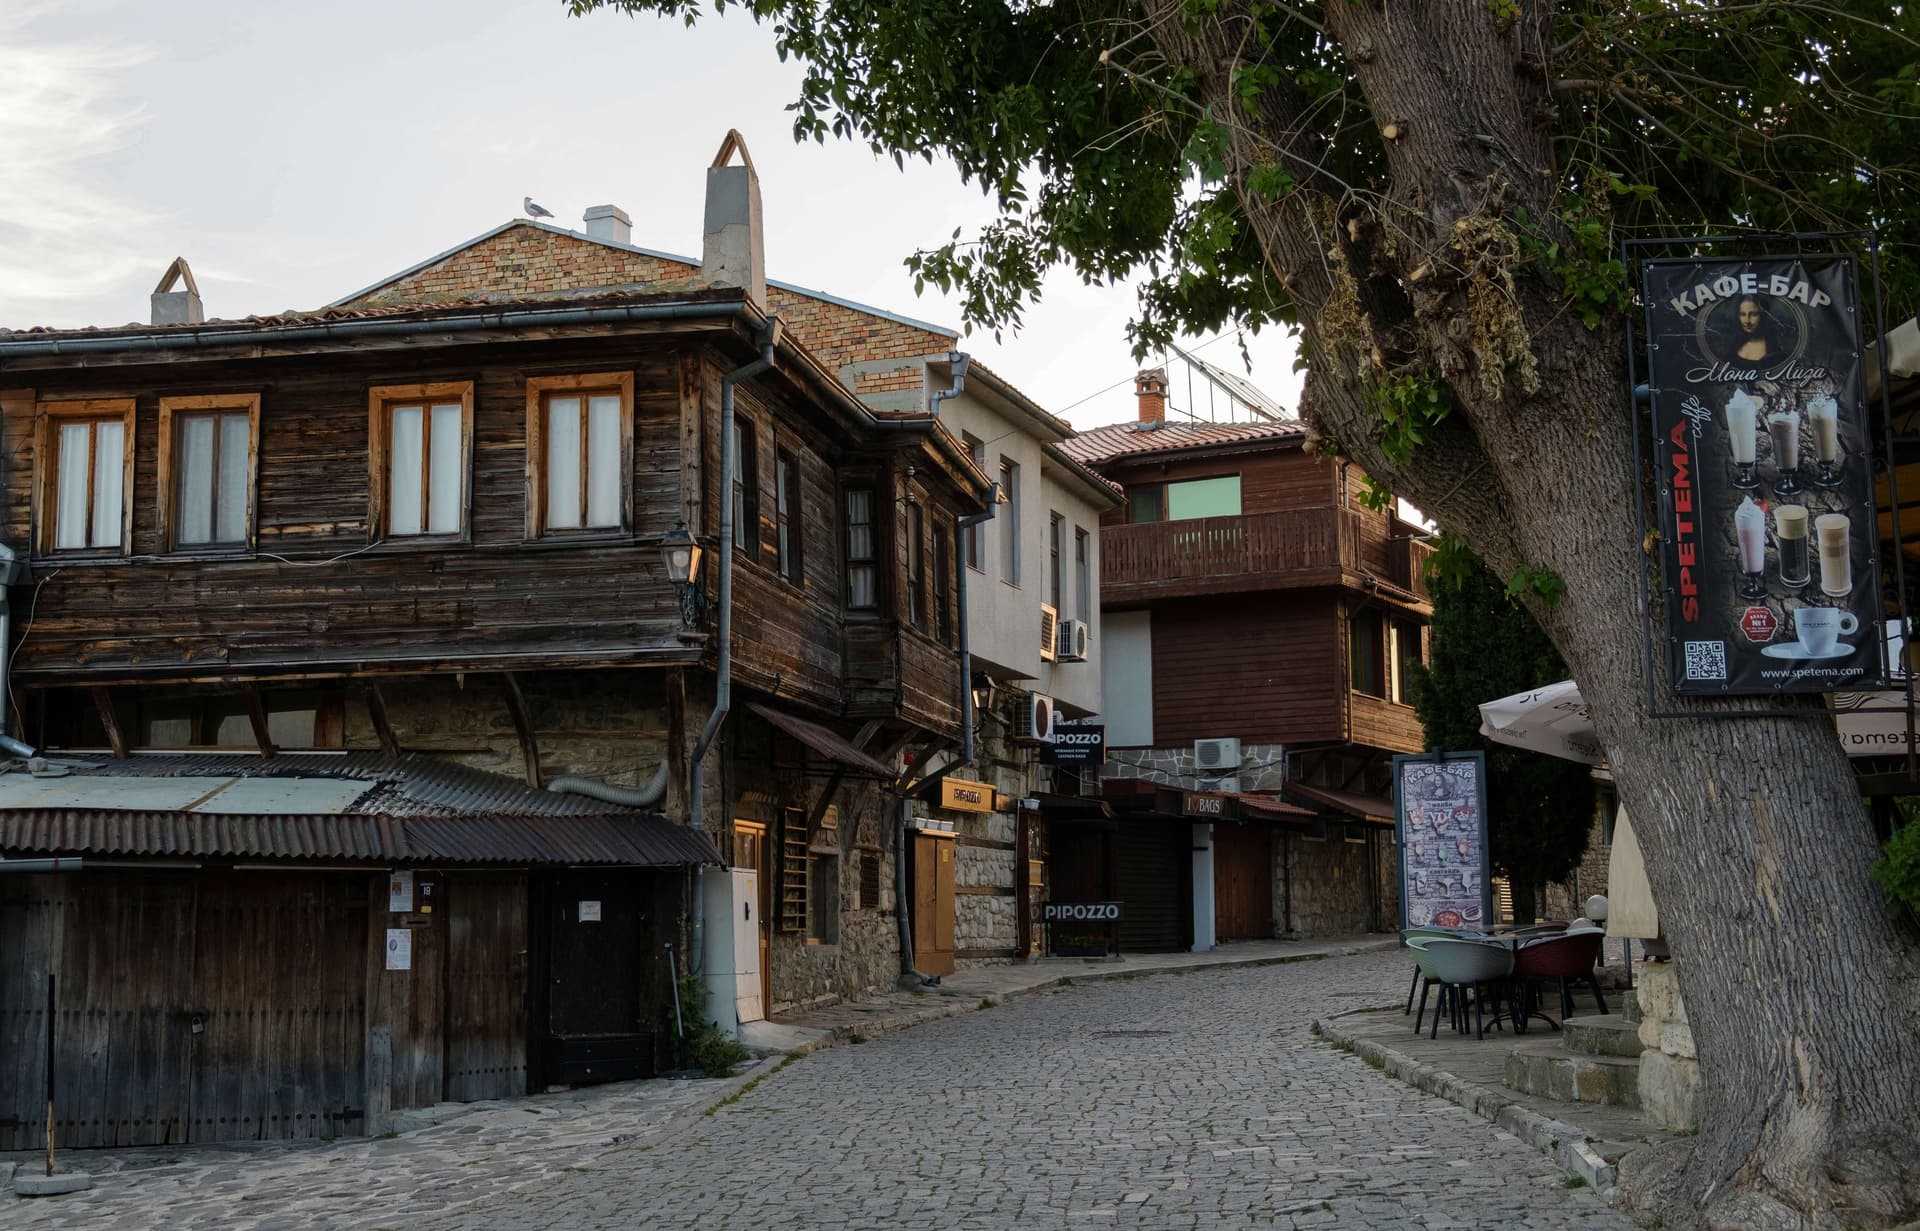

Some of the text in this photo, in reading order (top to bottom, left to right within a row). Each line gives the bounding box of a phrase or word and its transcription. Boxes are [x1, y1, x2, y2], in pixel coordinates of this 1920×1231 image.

[1670, 273, 1831, 317] КАФЕ-БАР
[1685, 360, 1826, 386] Мона Лиза
[1670, 418, 1699, 624] SPETEMA
[1761, 665, 1864, 678] www.spetema.com
[1053, 733, 1102, 745] IPOZZO
[1407, 765, 1472, 784] КАФЕ-БАР
[953, 788, 982, 804] PIPOZZO
[1199, 798, 1220, 813] BAGS
[1045, 904, 1119, 920] PIPOZZO
